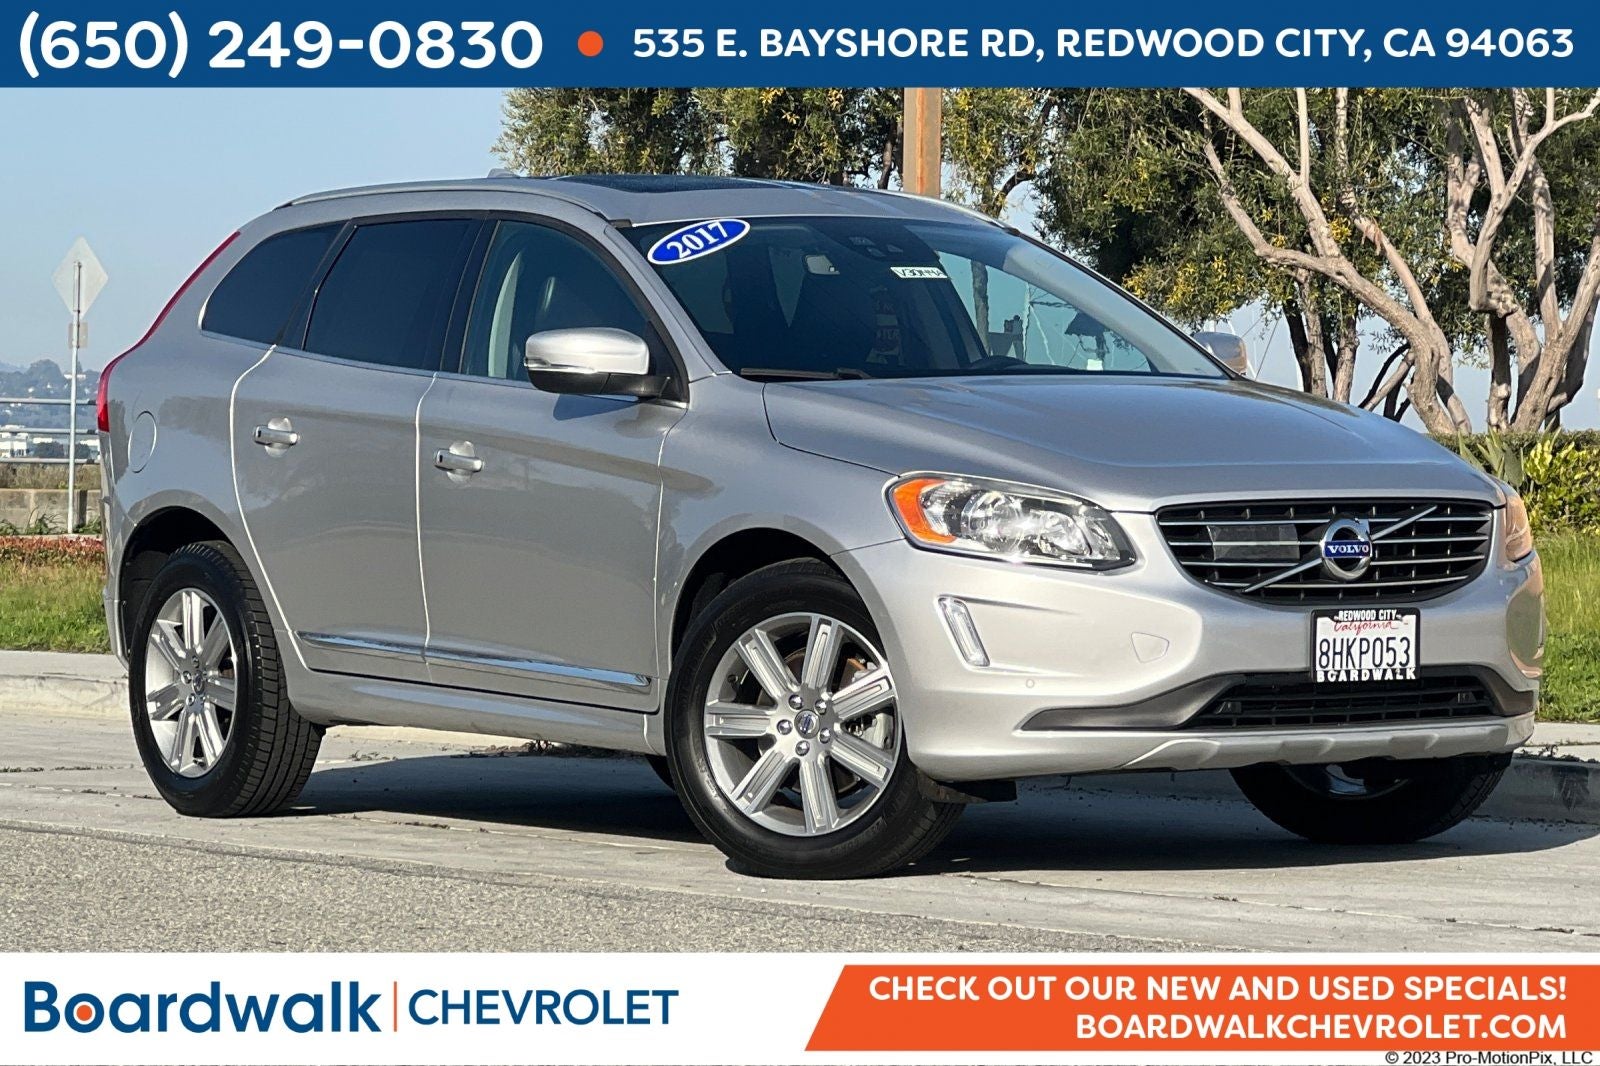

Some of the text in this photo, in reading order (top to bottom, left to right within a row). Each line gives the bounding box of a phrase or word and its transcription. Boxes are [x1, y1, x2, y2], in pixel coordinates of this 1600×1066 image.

[666, 221, 728, 259] 2017
[1327, 544, 1370, 554] VOLVO
[1338, 609, 1397, 621] REDWOOD CITY
[1333, 620, 1399, 635] California
[1318, 636, 1411, 669] 8HKP053
[1316, 667, 1417, 683] BOARDWALK
